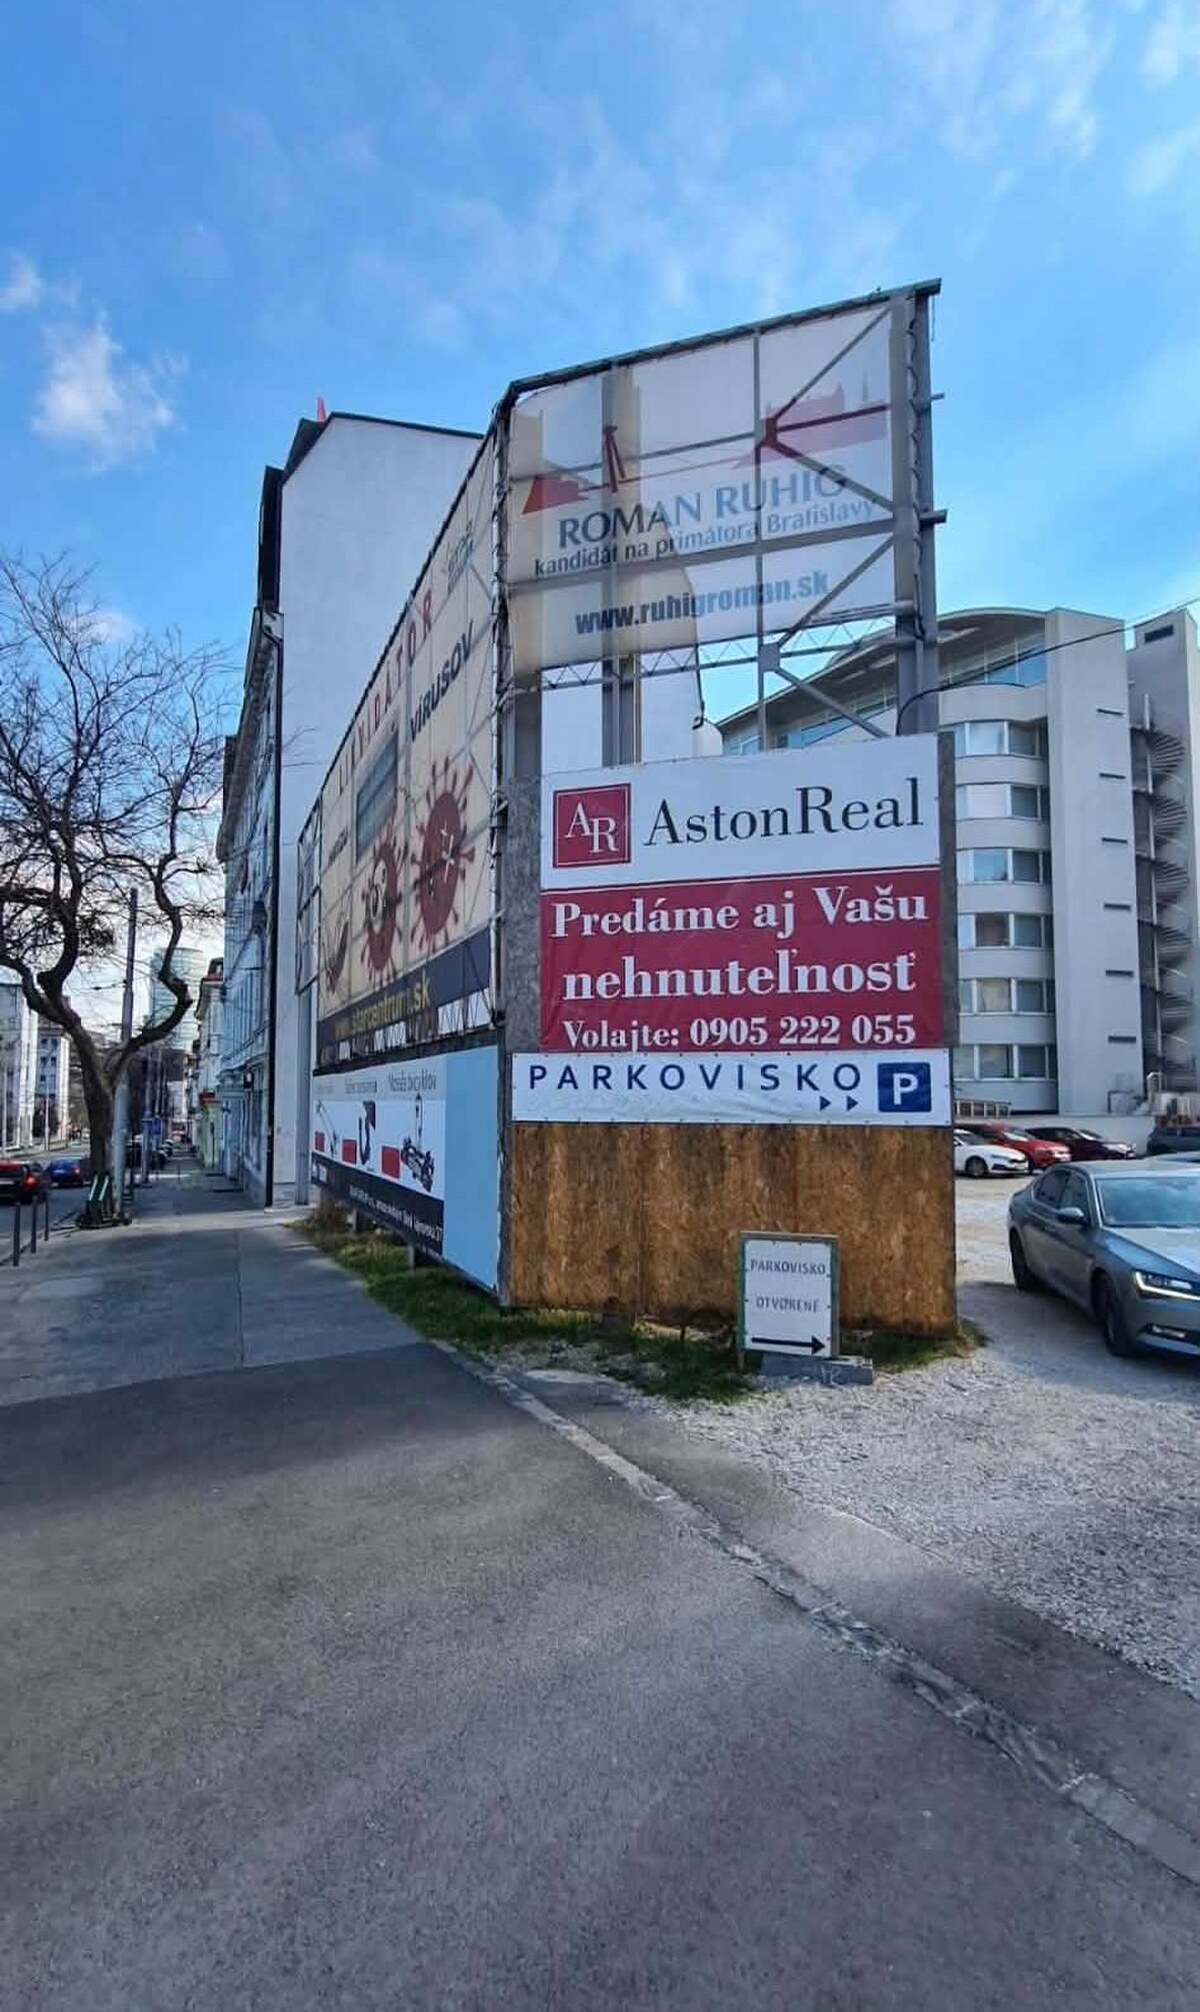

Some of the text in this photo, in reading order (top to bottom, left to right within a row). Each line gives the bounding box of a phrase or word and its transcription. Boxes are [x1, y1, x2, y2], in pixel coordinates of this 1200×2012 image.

[559, 492, 701, 549] ROMAN
[624, 541, 649, 561] na
[768, 500, 873, 534] Bratislavy
[575, 570, 828, 635] www.ruhigroman.sk
[643, 777, 924, 847] AstonReal
[551, 884, 930, 939] Predáme aj Vašu
[562, 949, 918, 1002] nehnuteľnosť
[562, 1014, 917, 1053] Volajte: 0905 222 055
[529, 1063, 861, 1092] PARKOVISKO
[750, 1259, 826, 1275] PARKOVISKO
